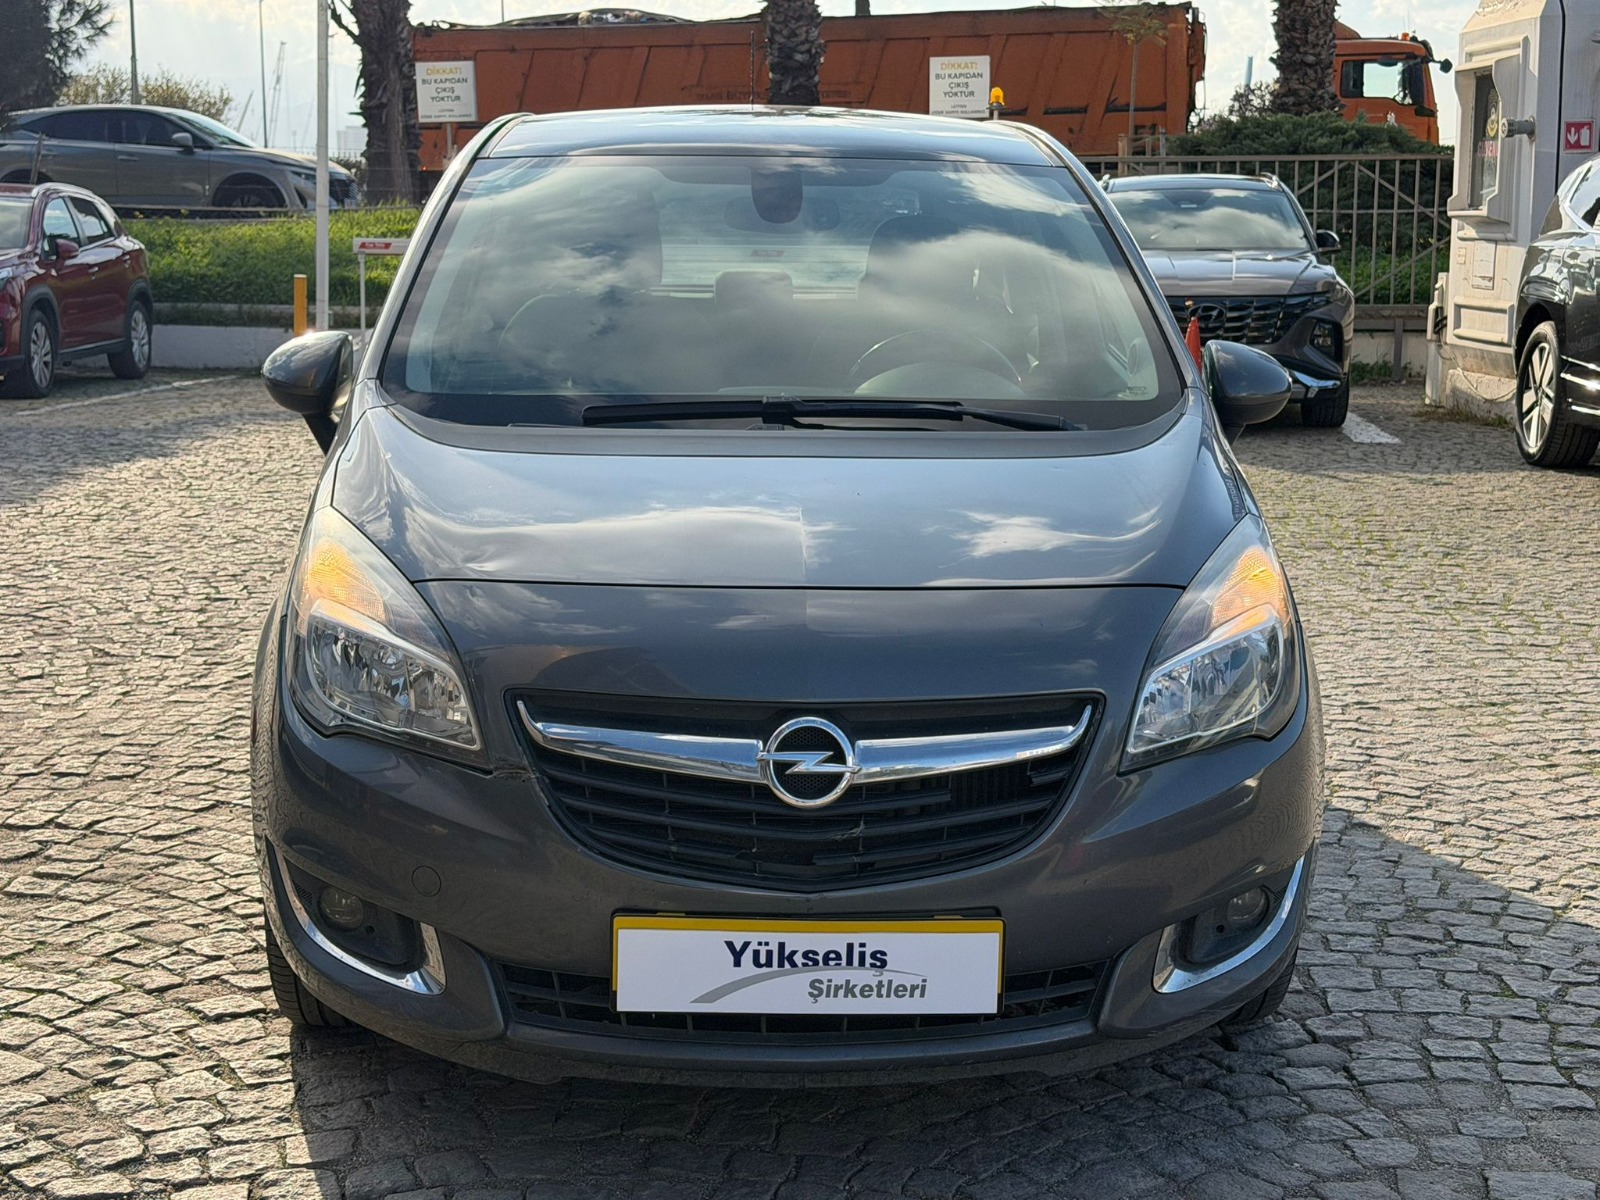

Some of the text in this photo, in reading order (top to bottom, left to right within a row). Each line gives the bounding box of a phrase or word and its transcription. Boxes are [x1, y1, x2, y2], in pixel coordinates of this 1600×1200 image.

[947, 72, 983, 80] KAPIDAN
[948, 81, 970, 90] ÇIKIŞ
[724, 940, 889, 978] Yükseliş
[807, 978, 928, 1004] Şirketleri
